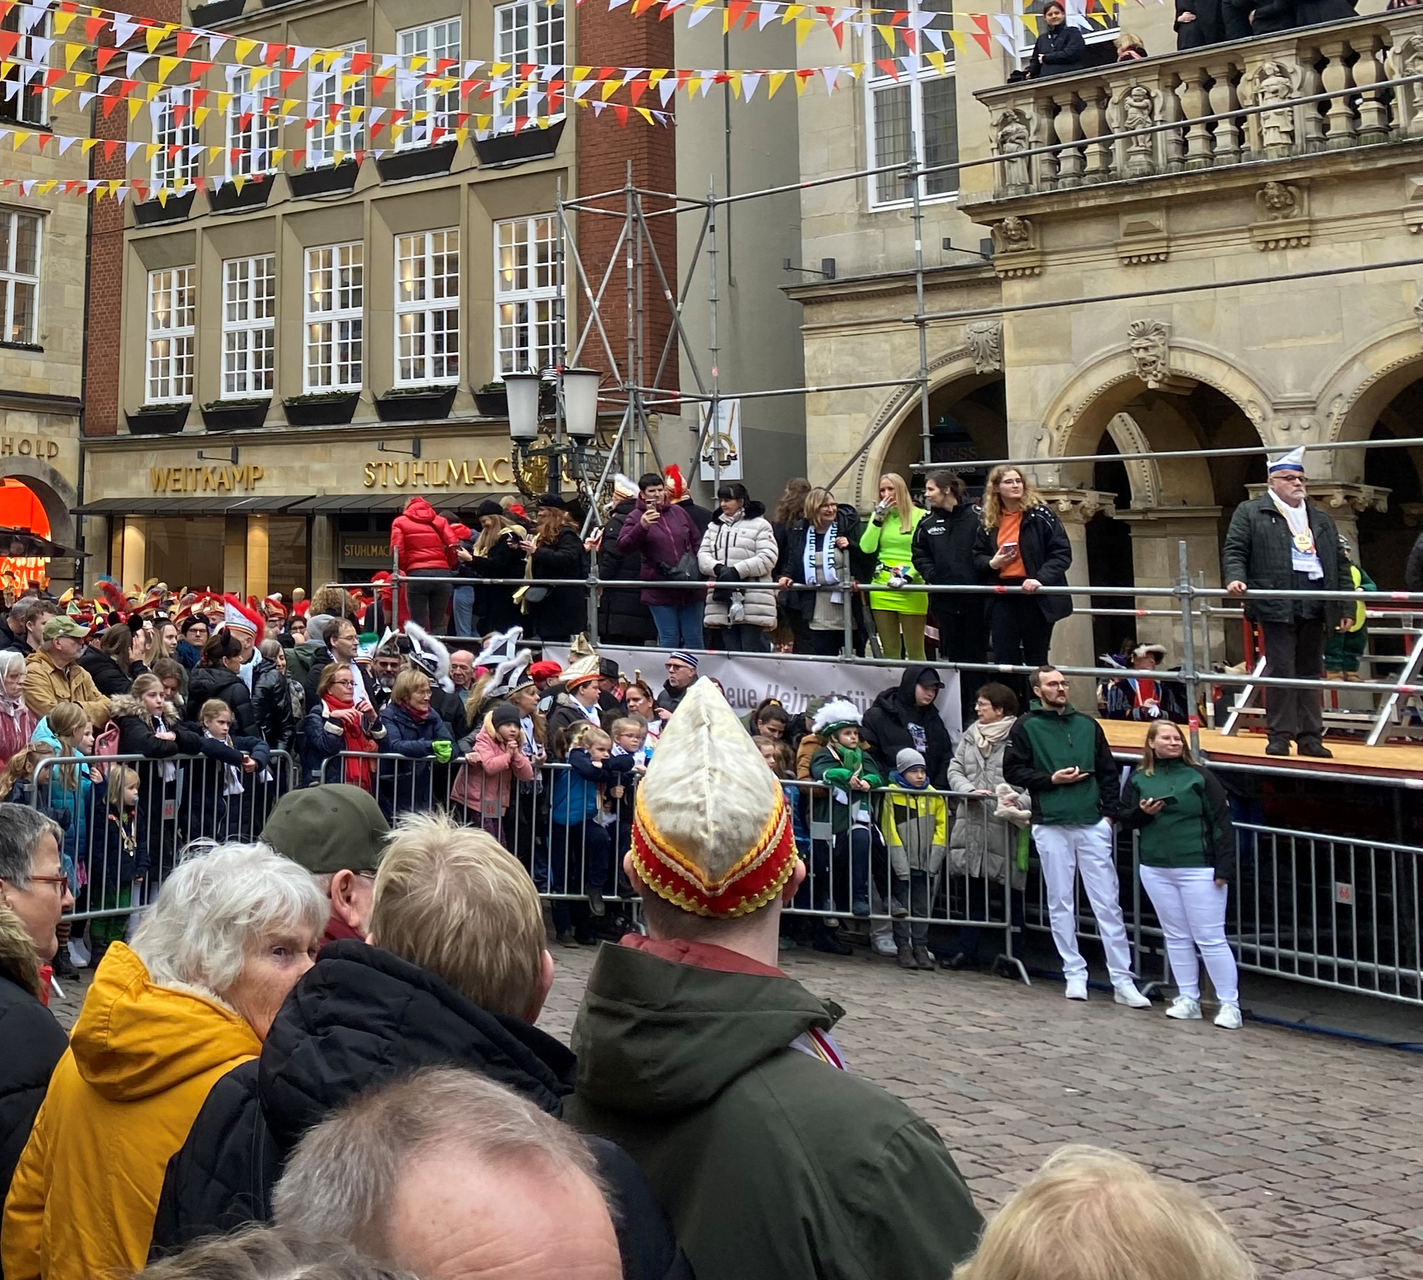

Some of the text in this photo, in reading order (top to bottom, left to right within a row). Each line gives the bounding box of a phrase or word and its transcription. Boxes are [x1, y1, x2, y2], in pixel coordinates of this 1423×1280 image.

[150, 465, 264, 492] WEITKAMP
[726, 686, 758, 709] eue
[766, 684, 837, 713] Heim
